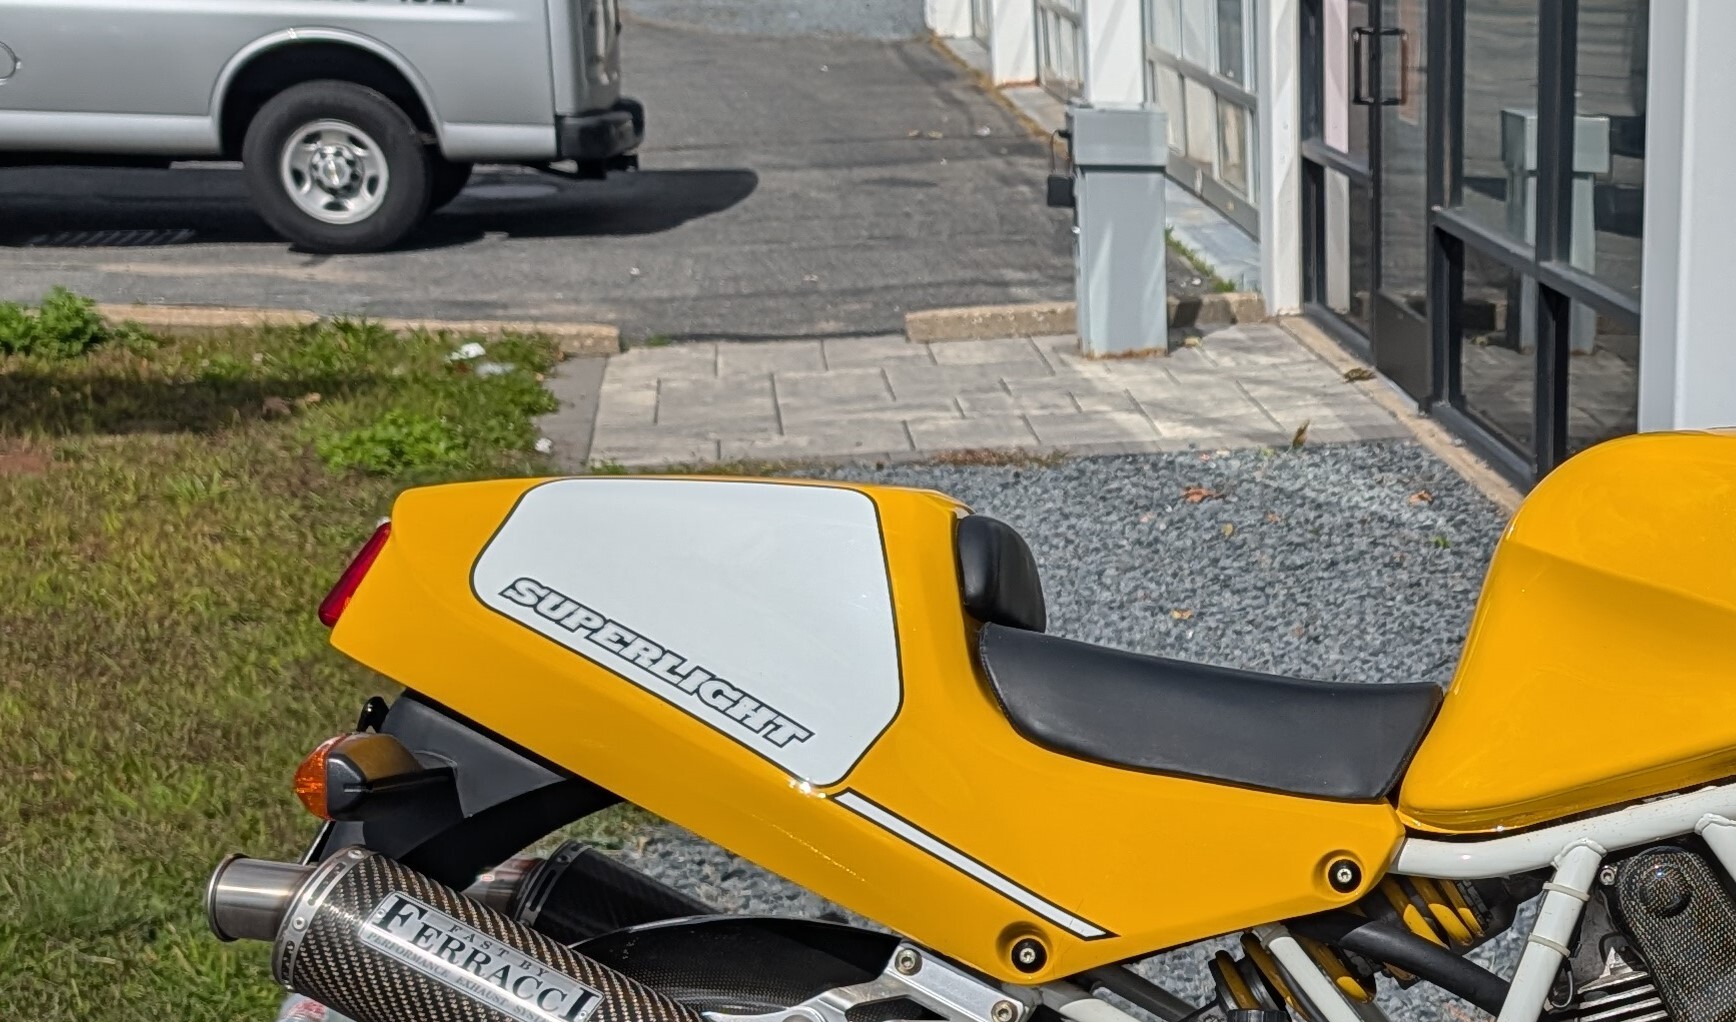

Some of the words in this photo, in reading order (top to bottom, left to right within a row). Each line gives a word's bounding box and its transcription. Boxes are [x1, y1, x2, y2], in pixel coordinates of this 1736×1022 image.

[498, 577, 815, 748] SUPERLIGHT
[366, 932, 451, 978] PERFORMANCE
[456, 976, 507, 1006] EXHAUST
[448, 924, 510, 957] FAST
[519, 960, 549, 978] BY
